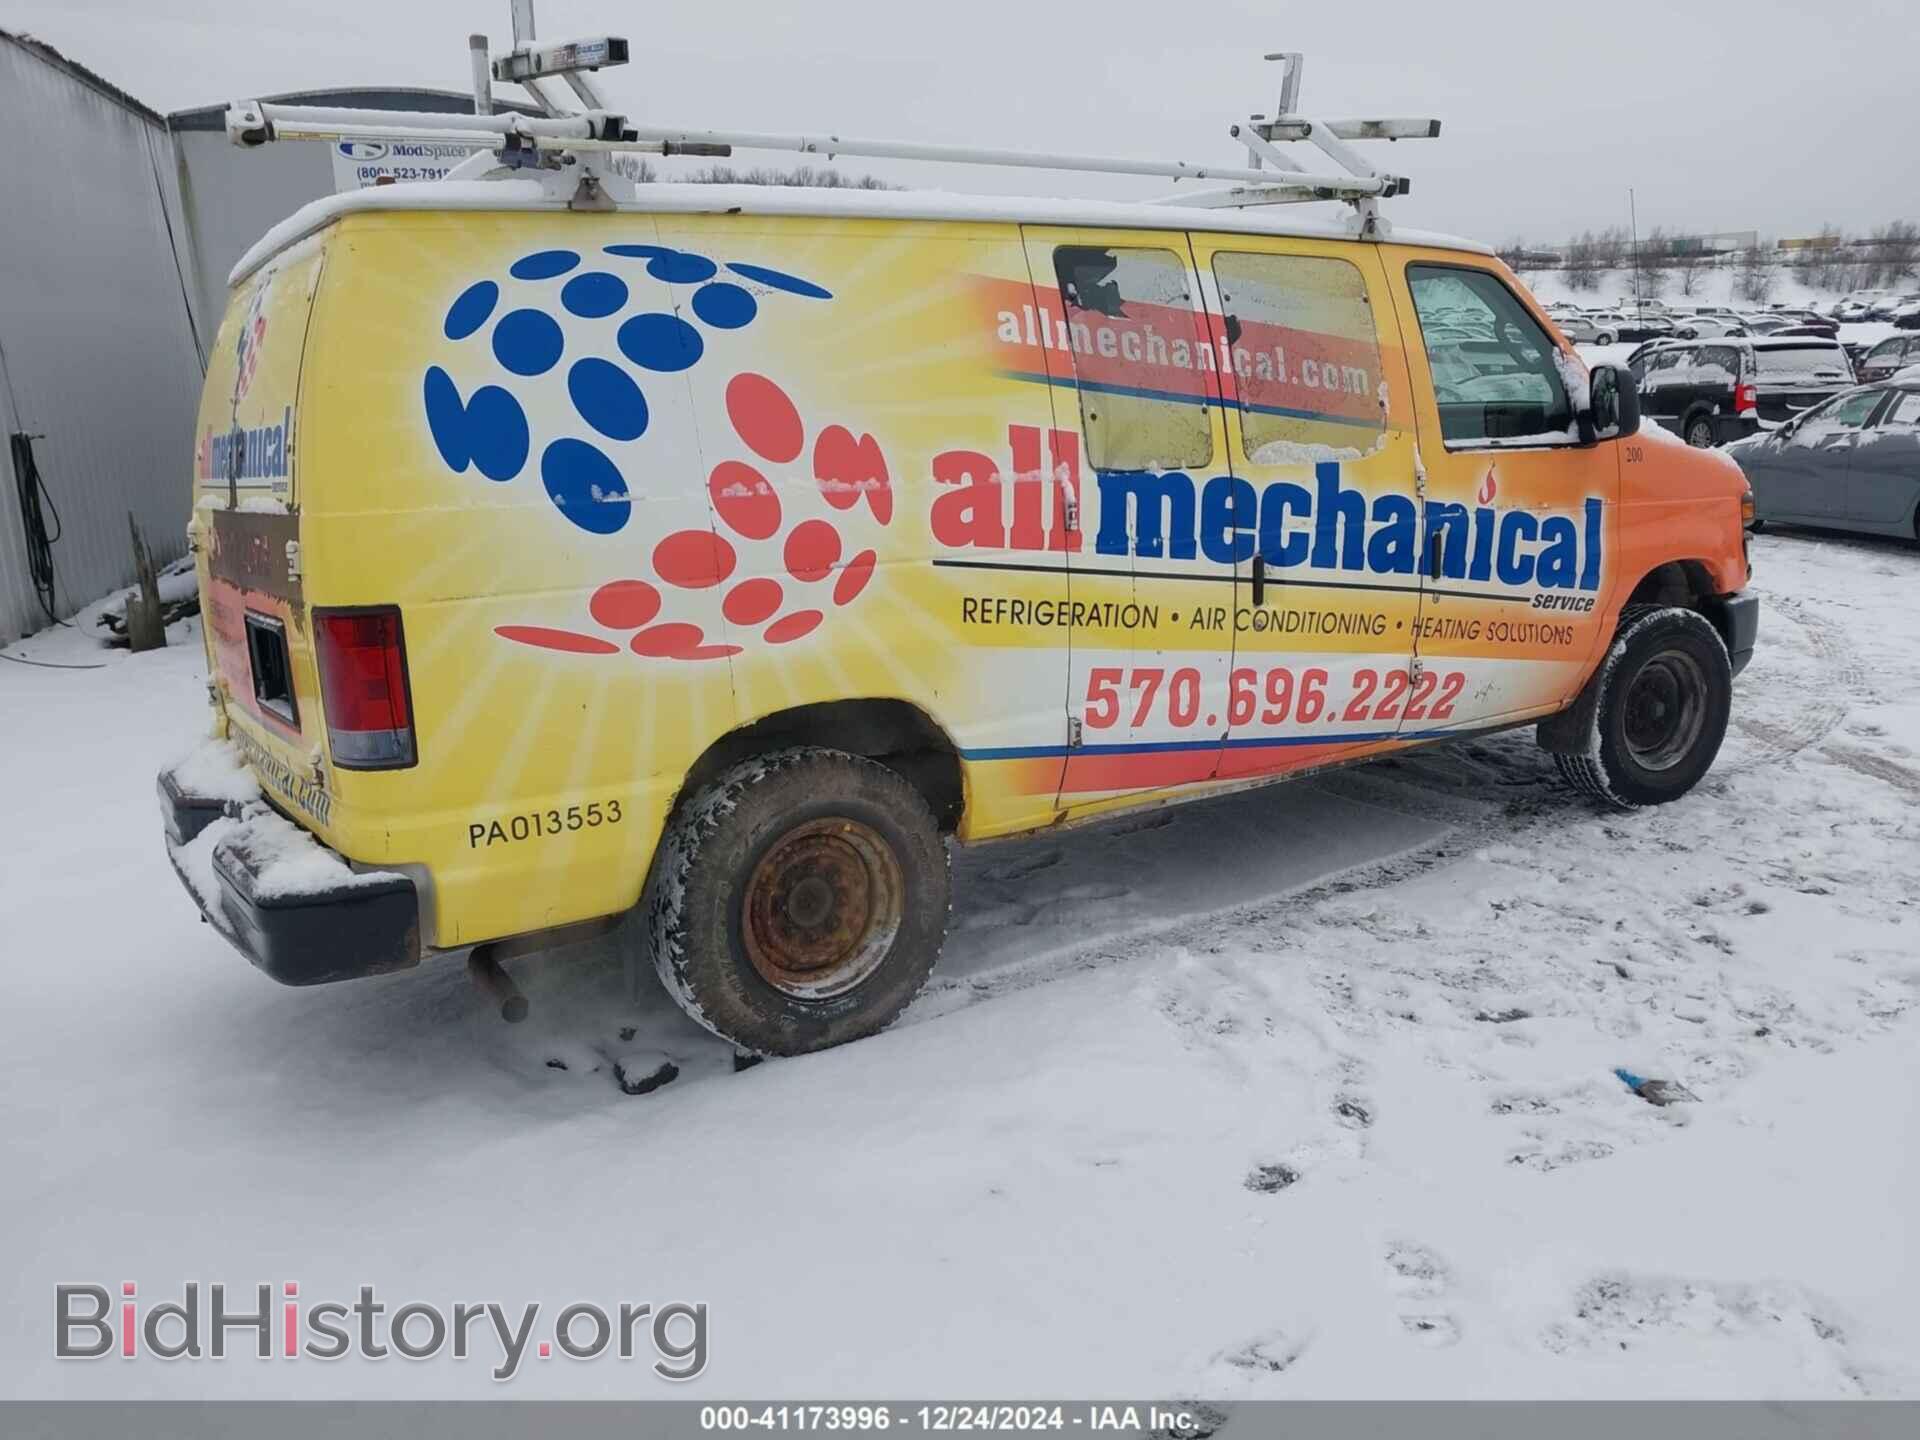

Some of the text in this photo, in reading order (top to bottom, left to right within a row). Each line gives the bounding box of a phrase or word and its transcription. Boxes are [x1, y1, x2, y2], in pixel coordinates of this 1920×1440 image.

[392, 144, 467, 161] ModSpace
[996, 303, 1371, 396] allmechanical.com
[929, 423, 1603, 592] all mechanical
[962, 597, 1574, 646] REFRIGERATION AIR CONDITIONING HEATING SOLUTIONS
[1531, 592, 1595, 613] service
[1084, 667, 1466, 729] 570.696.2222
[469, 800, 622, 848] PA013553
